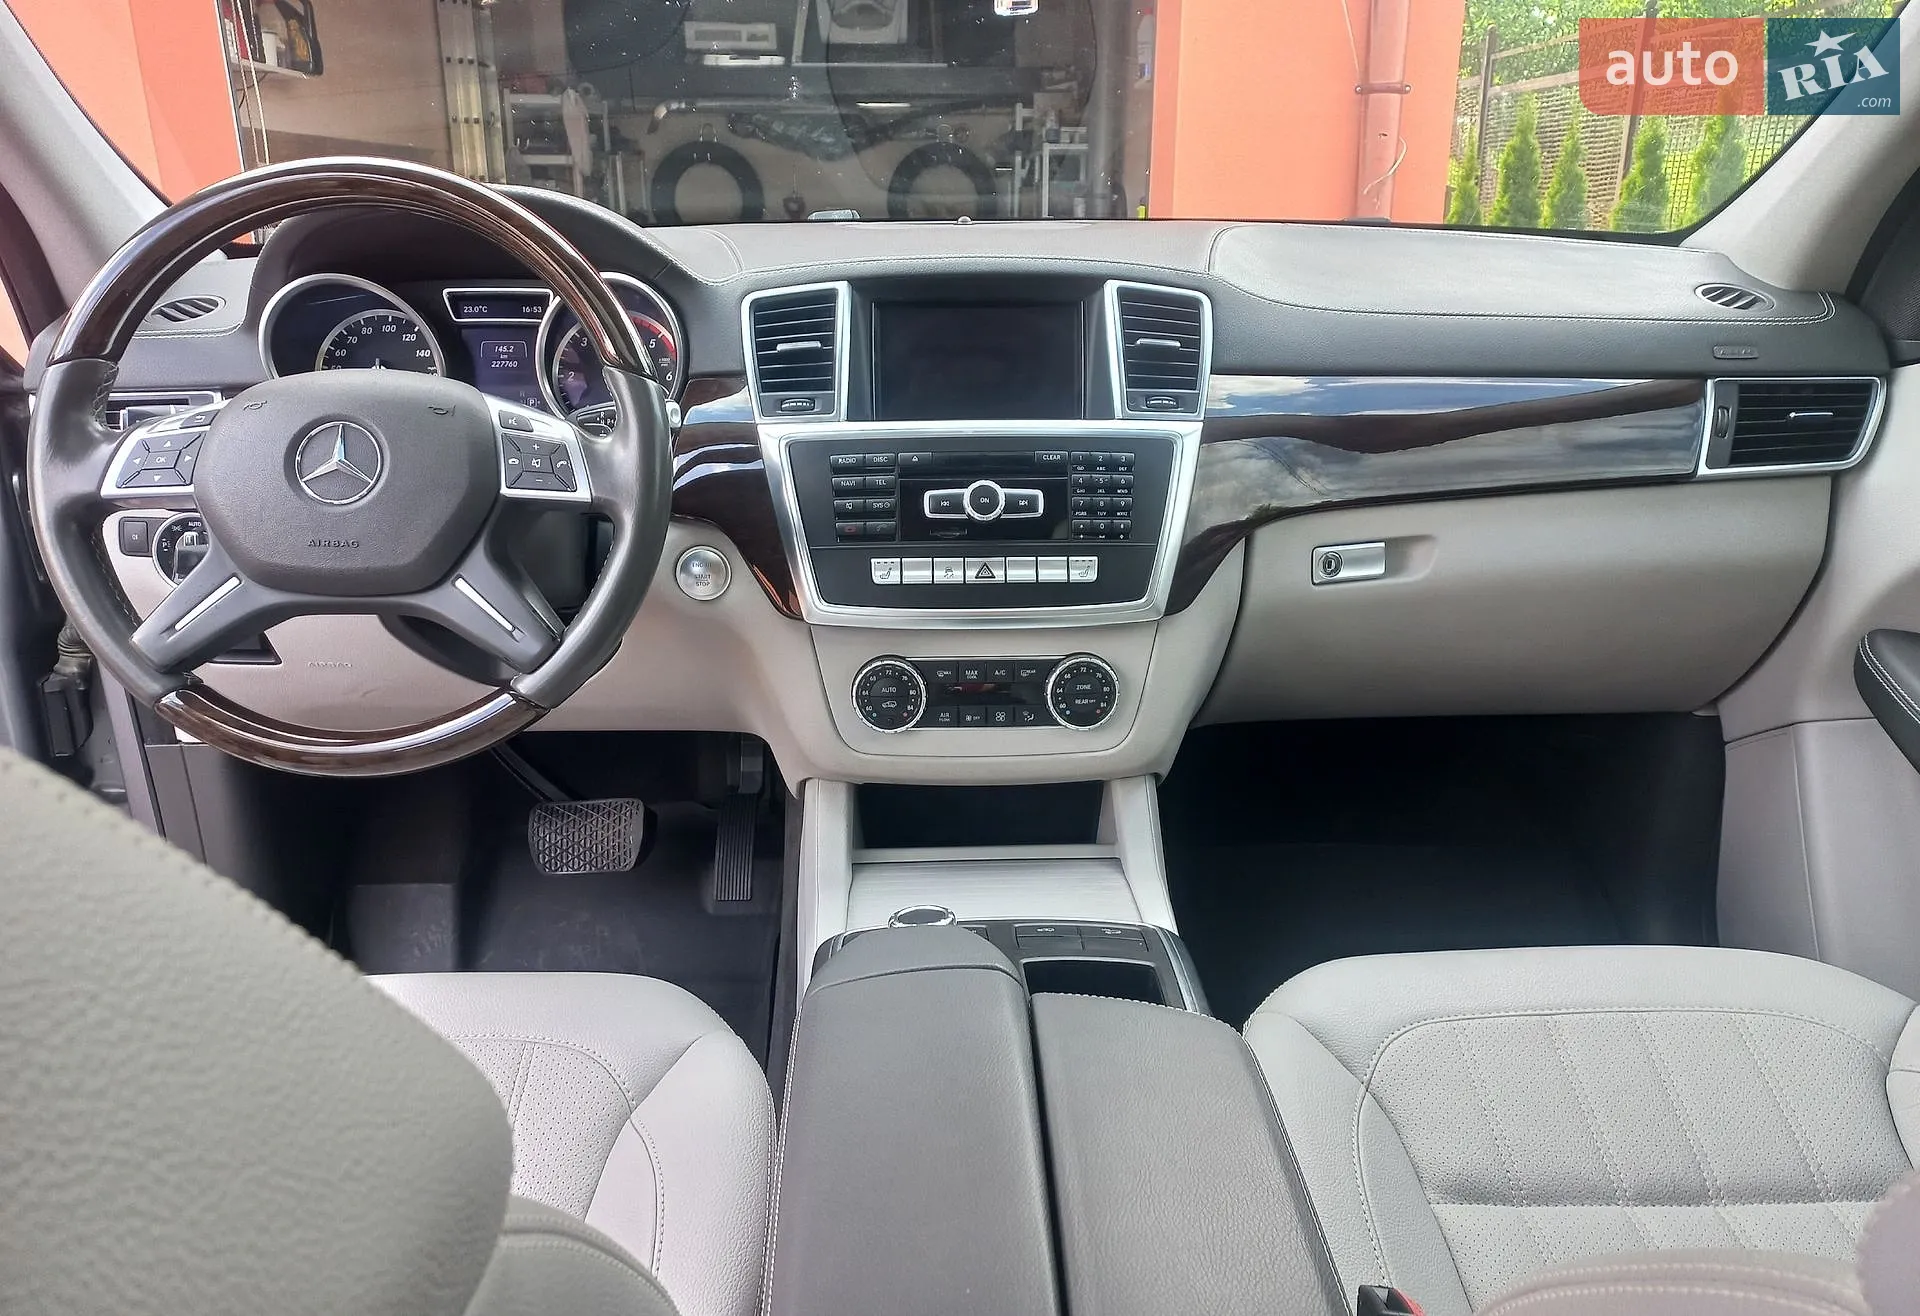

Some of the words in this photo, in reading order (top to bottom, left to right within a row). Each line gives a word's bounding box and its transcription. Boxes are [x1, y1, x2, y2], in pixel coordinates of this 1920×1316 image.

[580, 338, 588, 346] 3
[649, 339, 656, 348] 5
[568, 372, 575, 381] 2
[666, 371, 673, 380] 6
[308, 540, 360, 548] AIRBAG
